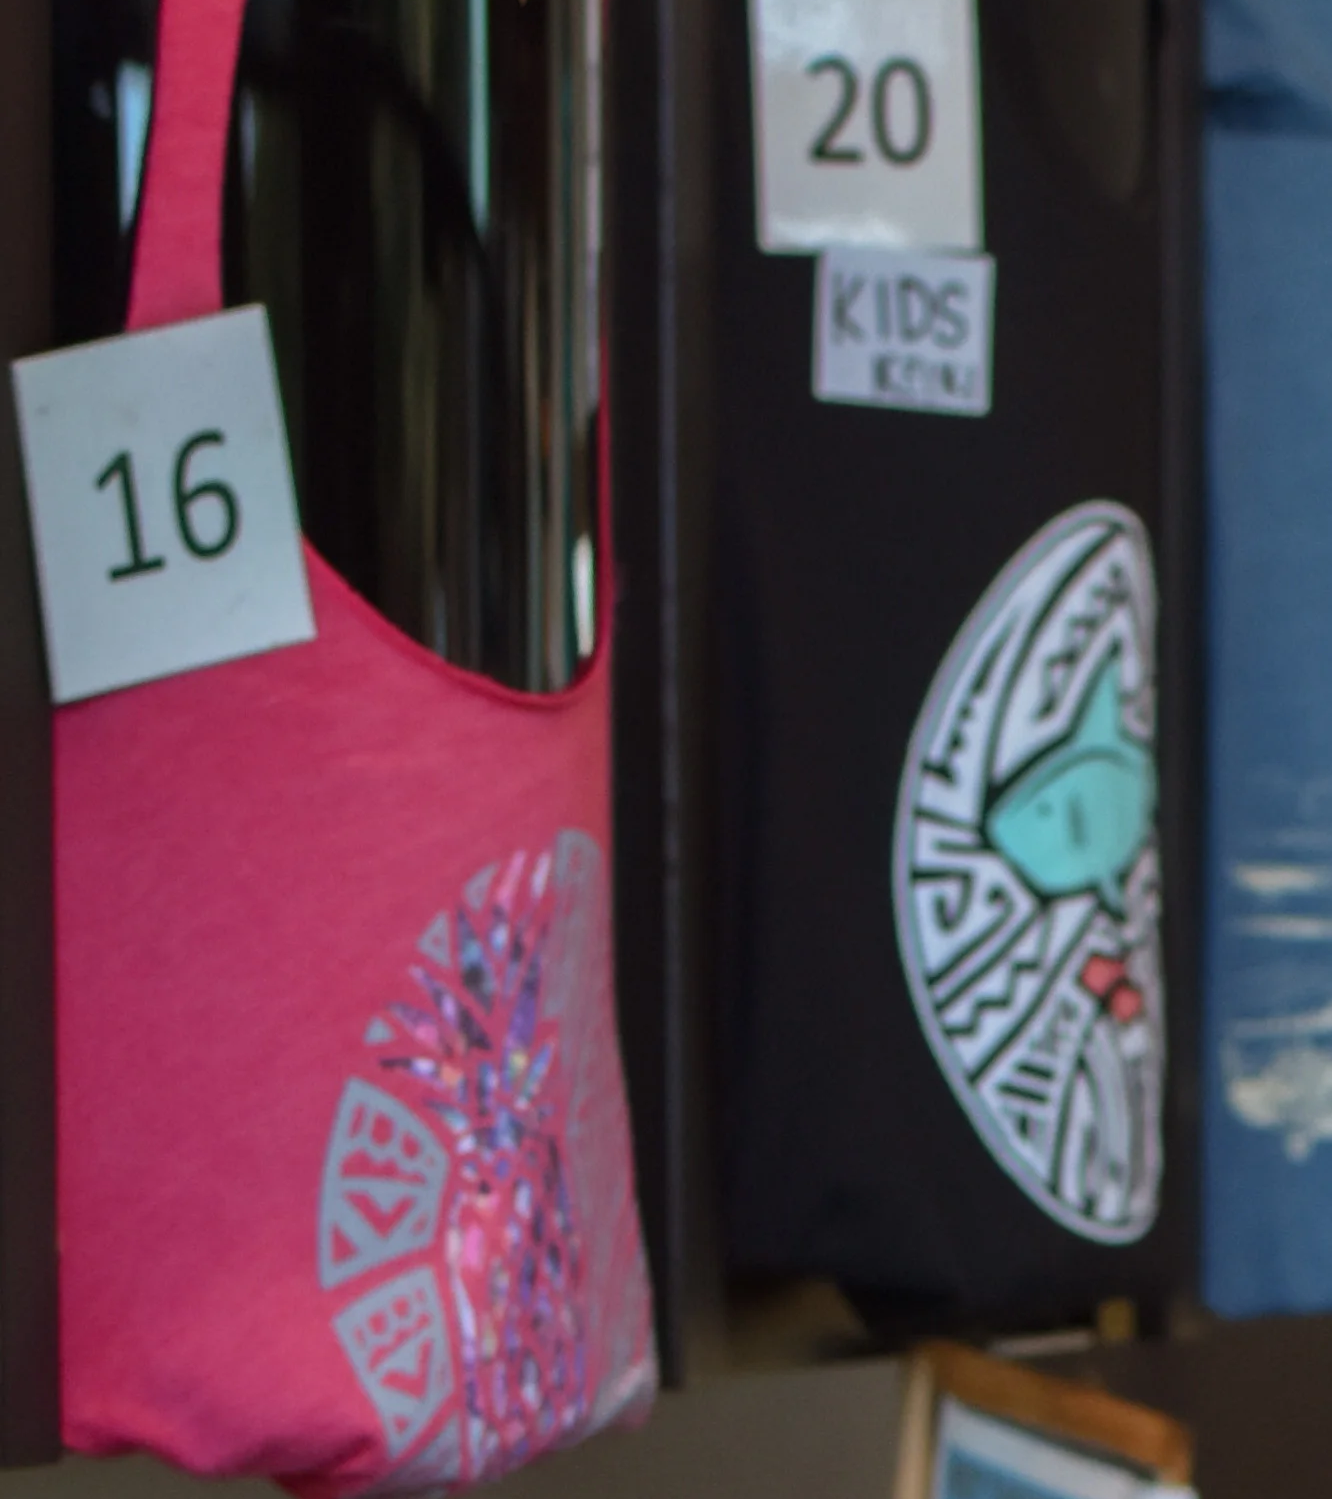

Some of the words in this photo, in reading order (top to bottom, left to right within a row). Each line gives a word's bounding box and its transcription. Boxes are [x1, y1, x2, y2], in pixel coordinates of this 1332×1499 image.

[807, 54, 934, 168] 20
[831, 271, 970, 351] KIDS
[94, 427, 241, 585] 16
